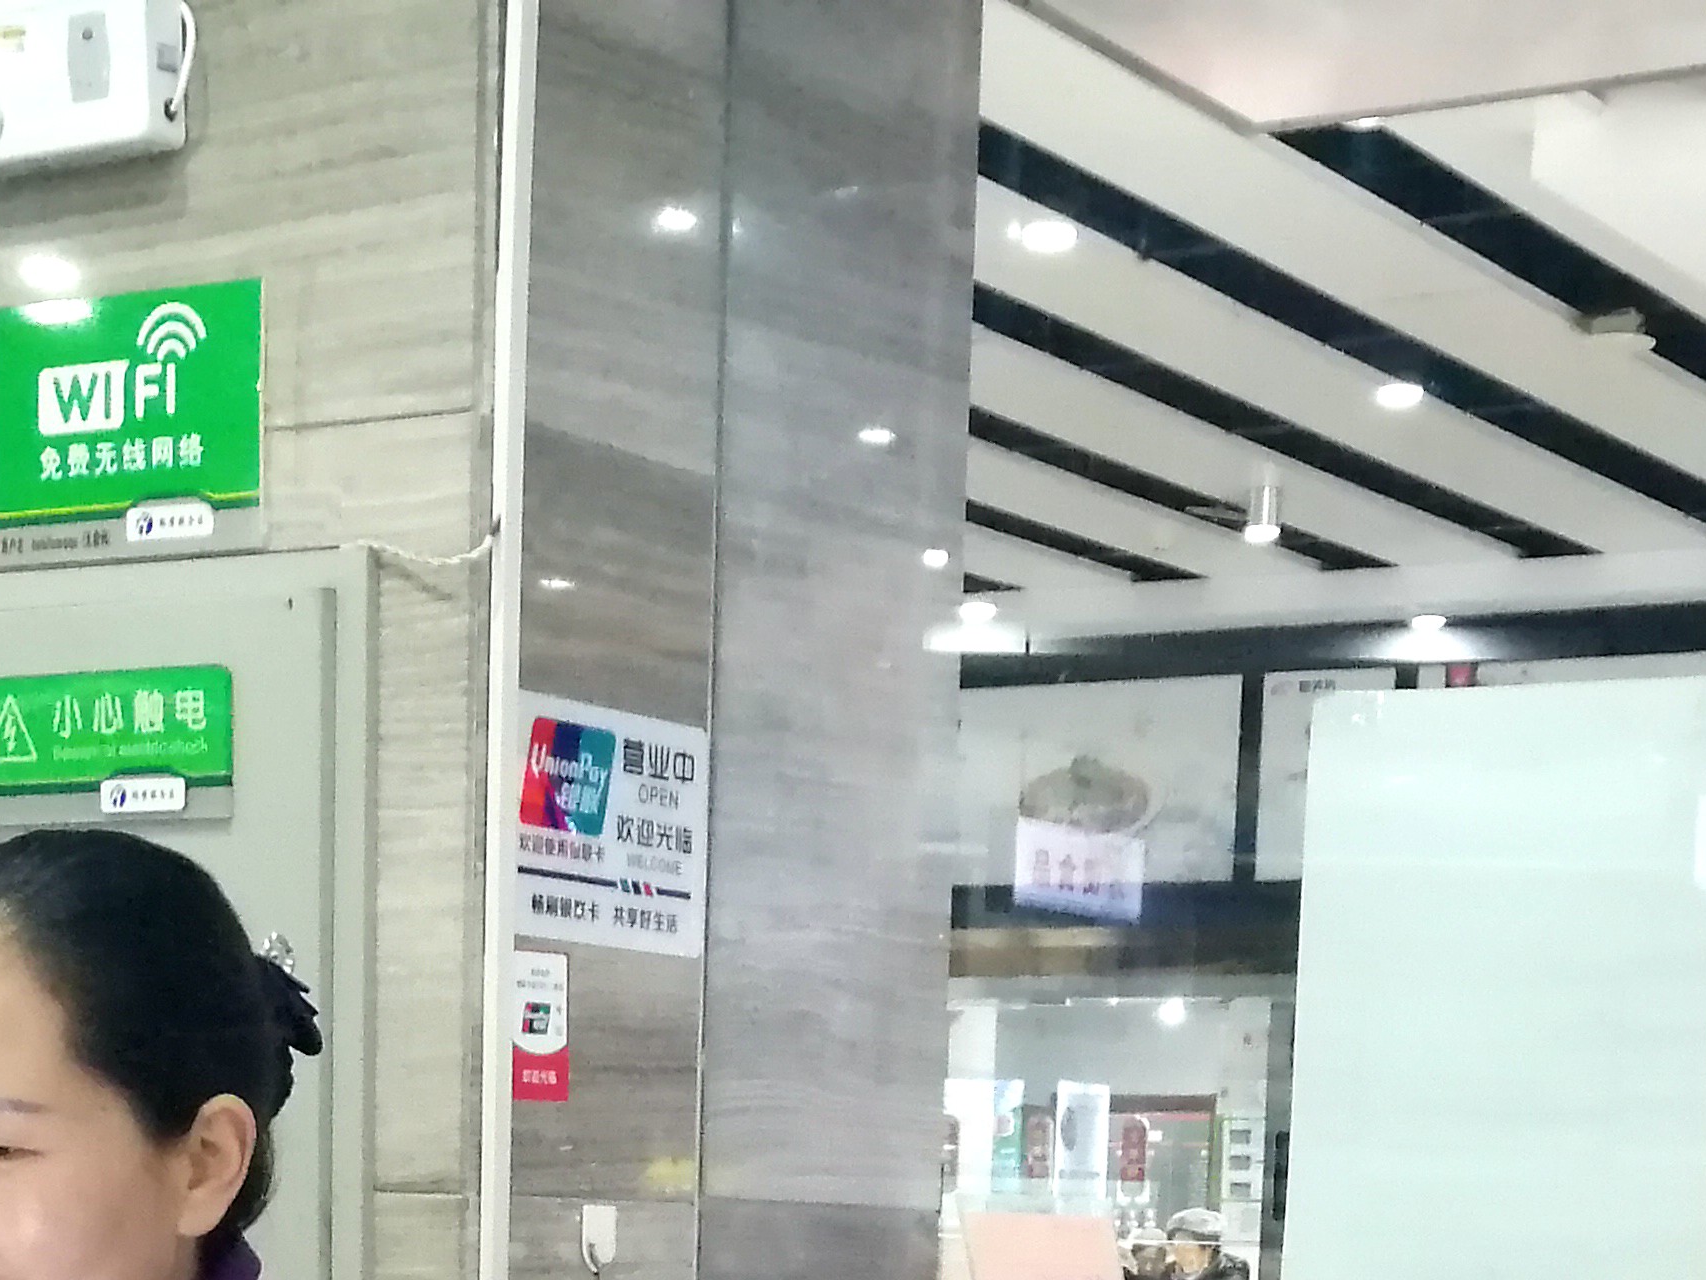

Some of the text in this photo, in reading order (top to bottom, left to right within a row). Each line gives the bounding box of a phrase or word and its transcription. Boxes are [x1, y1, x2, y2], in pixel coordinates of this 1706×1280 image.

[52, 361, 177, 425] WIFI
[40, 433, 204, 481] 免费无线网络
[53, 686, 207, 739] 小心触电
[530, 743, 609, 787] UnionPay
[623, 737, 695, 783] 营业中
[638, 784, 680, 810] OPEN
[617, 814, 693, 854] 欢迎光临
[626, 852, 683, 876] WELCOME
[613, 907, 678, 934] 共享好生活
